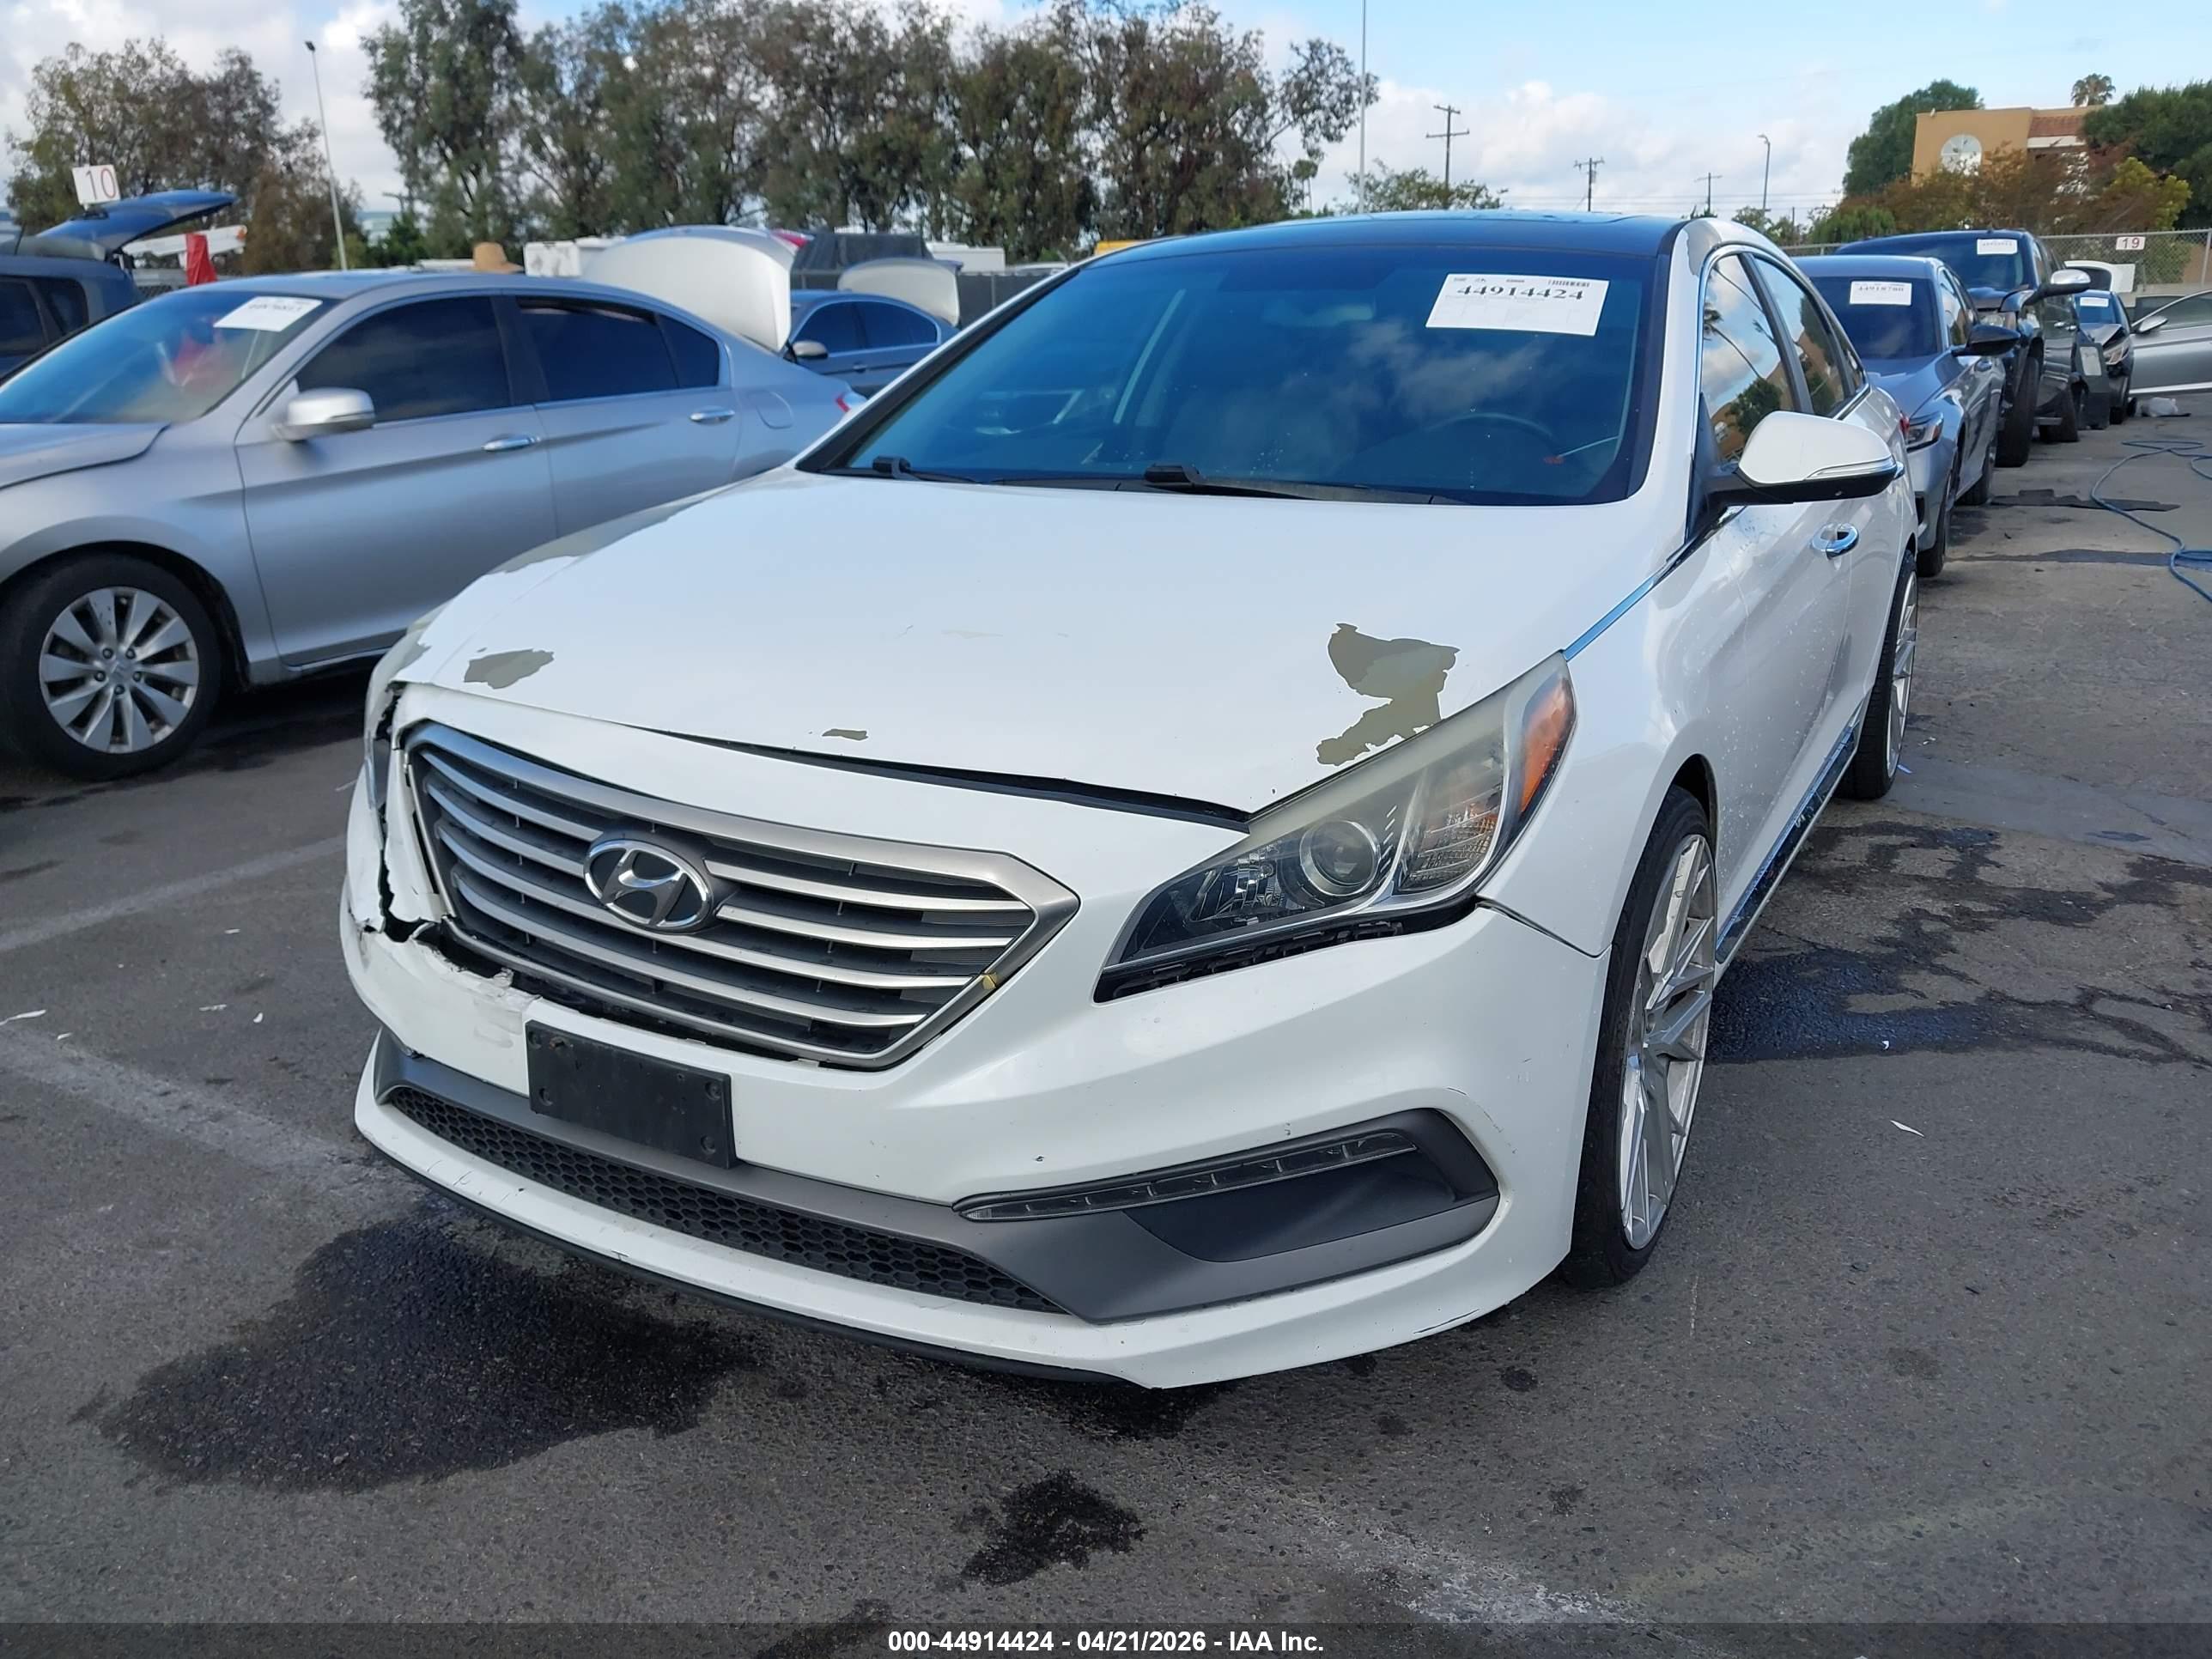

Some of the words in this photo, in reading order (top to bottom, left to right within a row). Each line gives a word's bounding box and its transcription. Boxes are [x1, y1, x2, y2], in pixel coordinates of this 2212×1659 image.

[85, 167, 117, 200] 10
[2122, 237, 2141, 249] 19
[1456, 284, 1583, 301] 44914424
